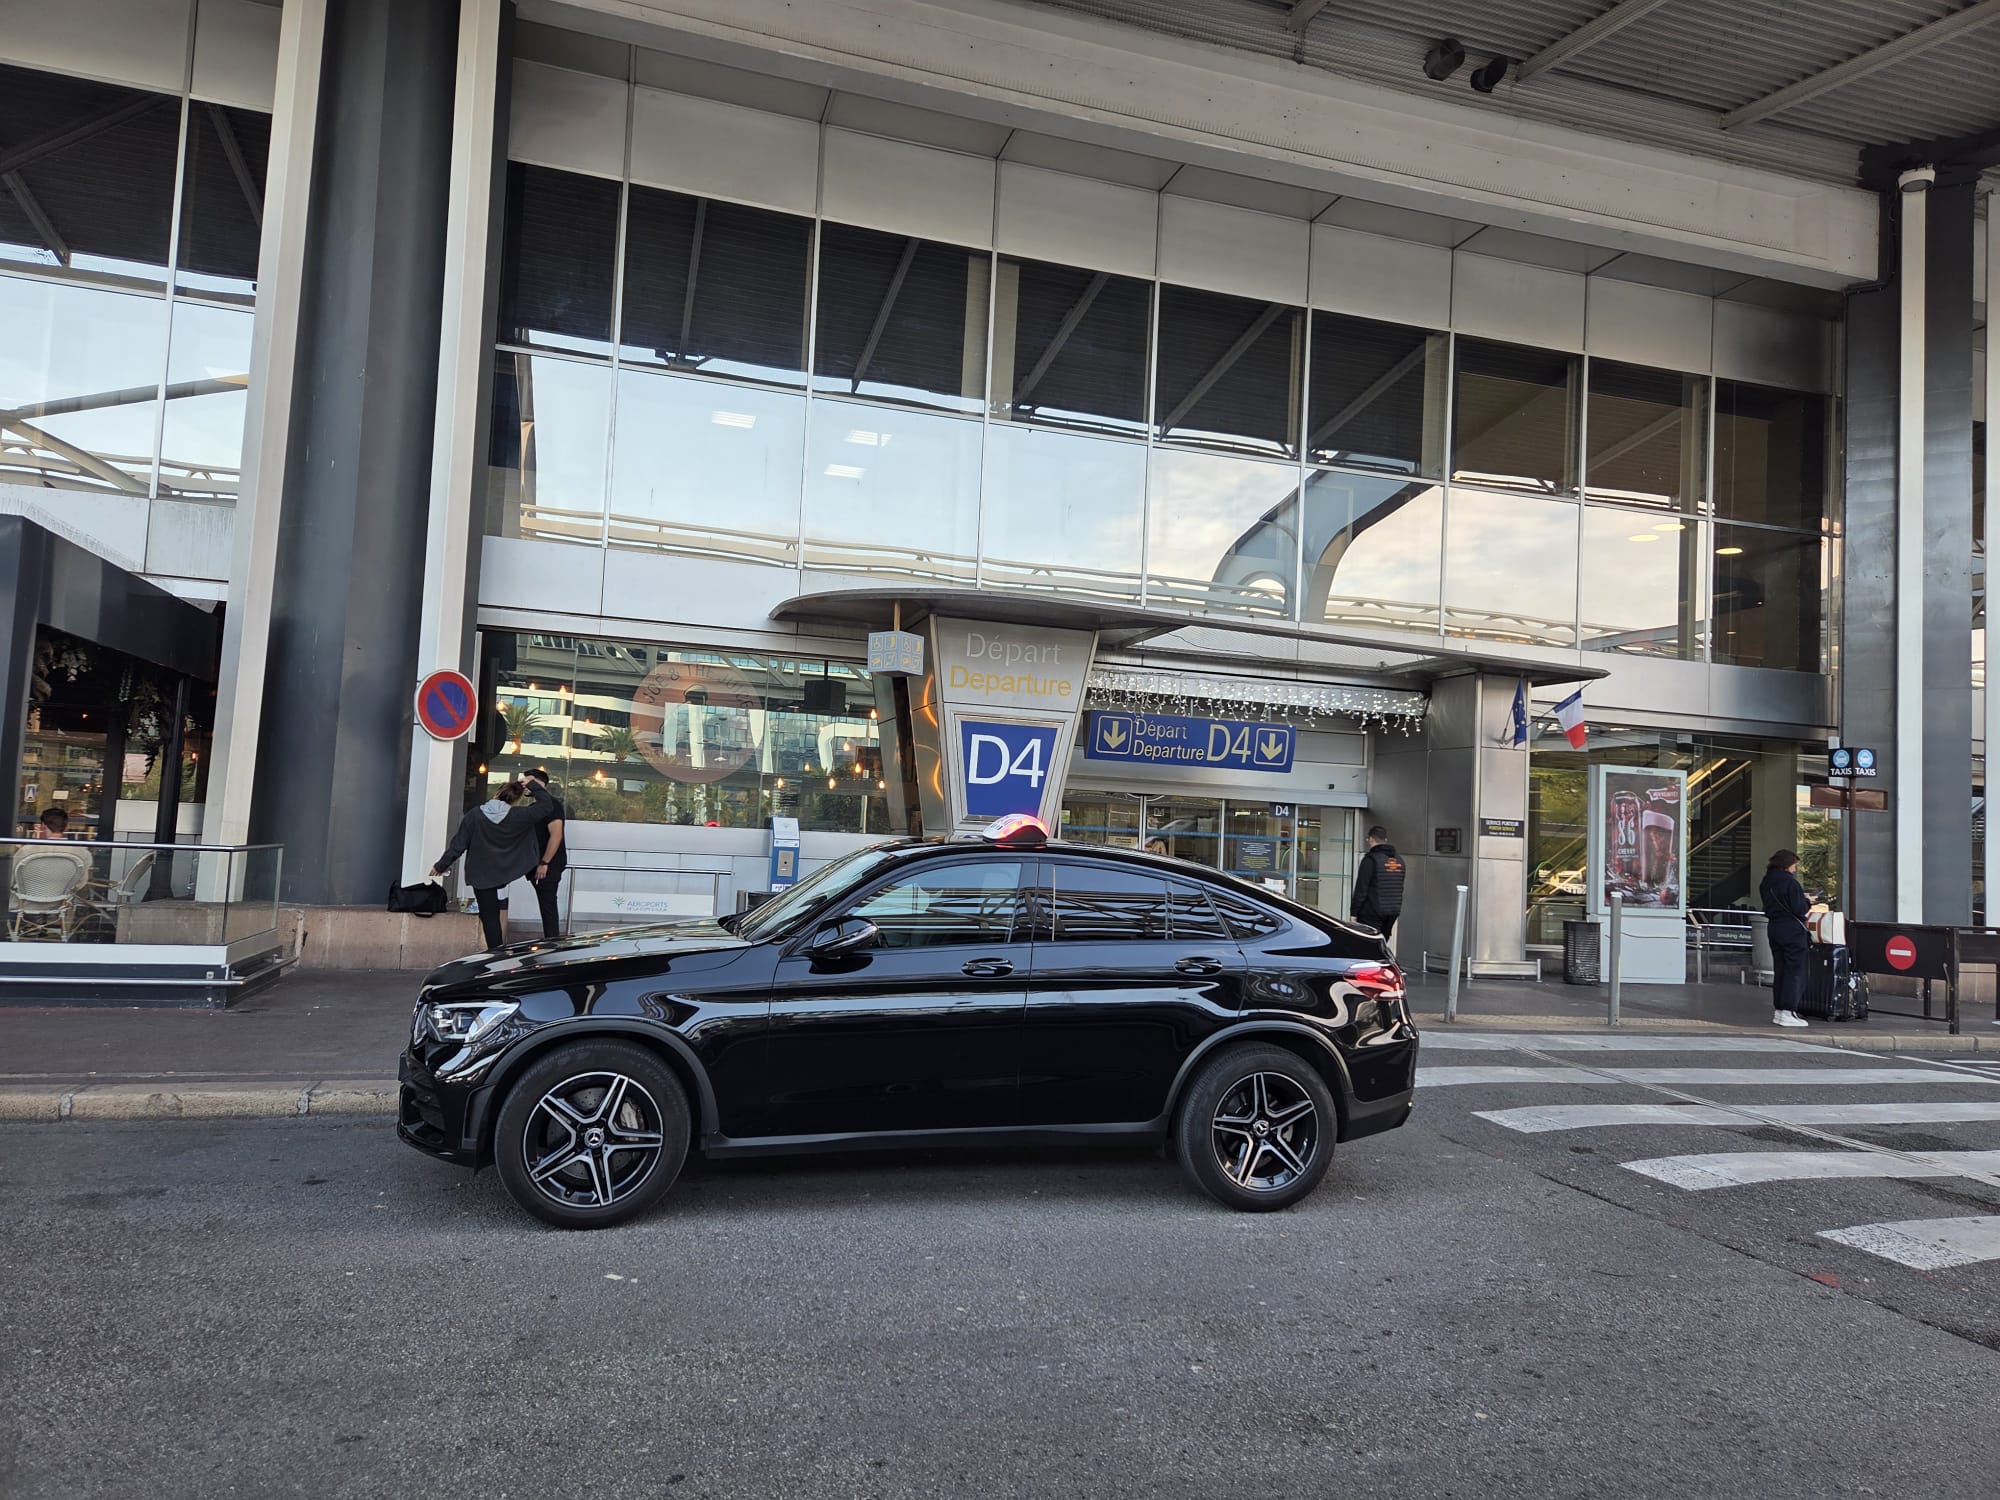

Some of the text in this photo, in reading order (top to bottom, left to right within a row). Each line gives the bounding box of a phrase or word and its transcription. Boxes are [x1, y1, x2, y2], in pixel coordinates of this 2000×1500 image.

[966, 632, 1061, 666] Départ
[950, 665, 1071, 697] Departure
[1135, 718, 1187, 740] Départ
[1133, 723, 1252, 763] Departure D4
[968, 734, 1044, 788] D4
[1830, 768, 1852, 776] TAXIS
[1855, 768, 1876, 776] TAXIS
[1275, 805, 1289, 817] D4
